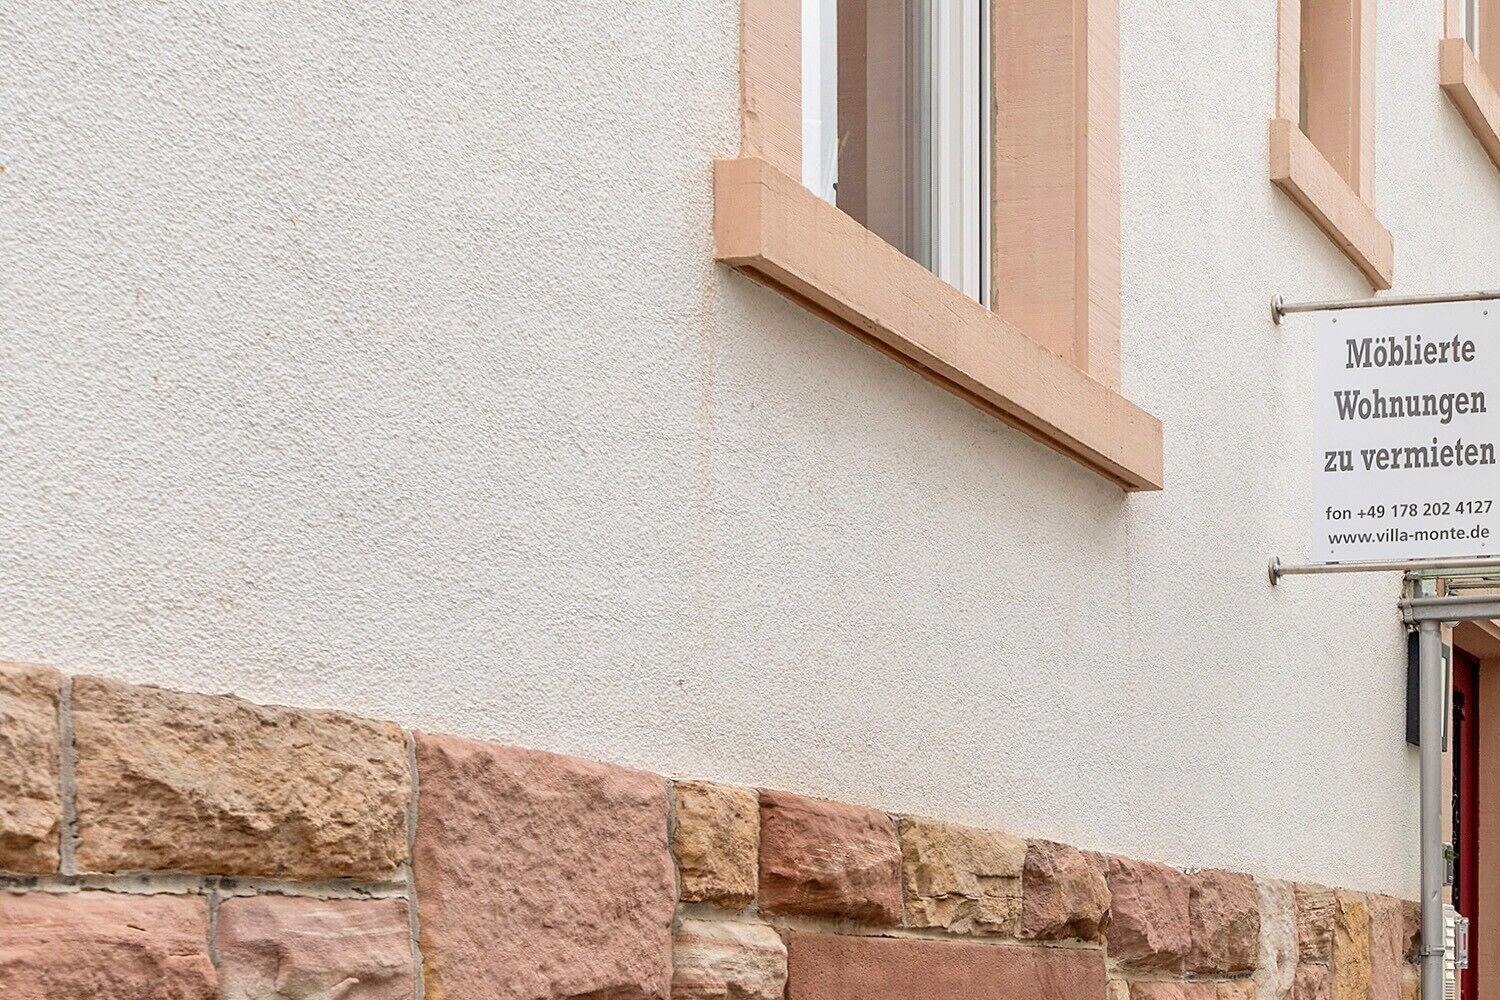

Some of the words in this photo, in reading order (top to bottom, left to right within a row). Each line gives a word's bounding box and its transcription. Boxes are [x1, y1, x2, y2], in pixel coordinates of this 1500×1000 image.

[1346, 334, 1475, 368] Möblierte
[1334, 389, 1486, 424] Wohnungen
[1324, 450, 1353, 472] zu
[1361, 437, 1496, 470] vermieten
[1326, 506, 1351, 520] fon
[1357, 505, 1385, 519] +49
[1391, 504, 1418, 517] 178
[1423, 502, 1450, 516] 202
[1455, 501, 1493, 515] 4127
[1328, 525, 1490, 544] www.villa-monte.de
